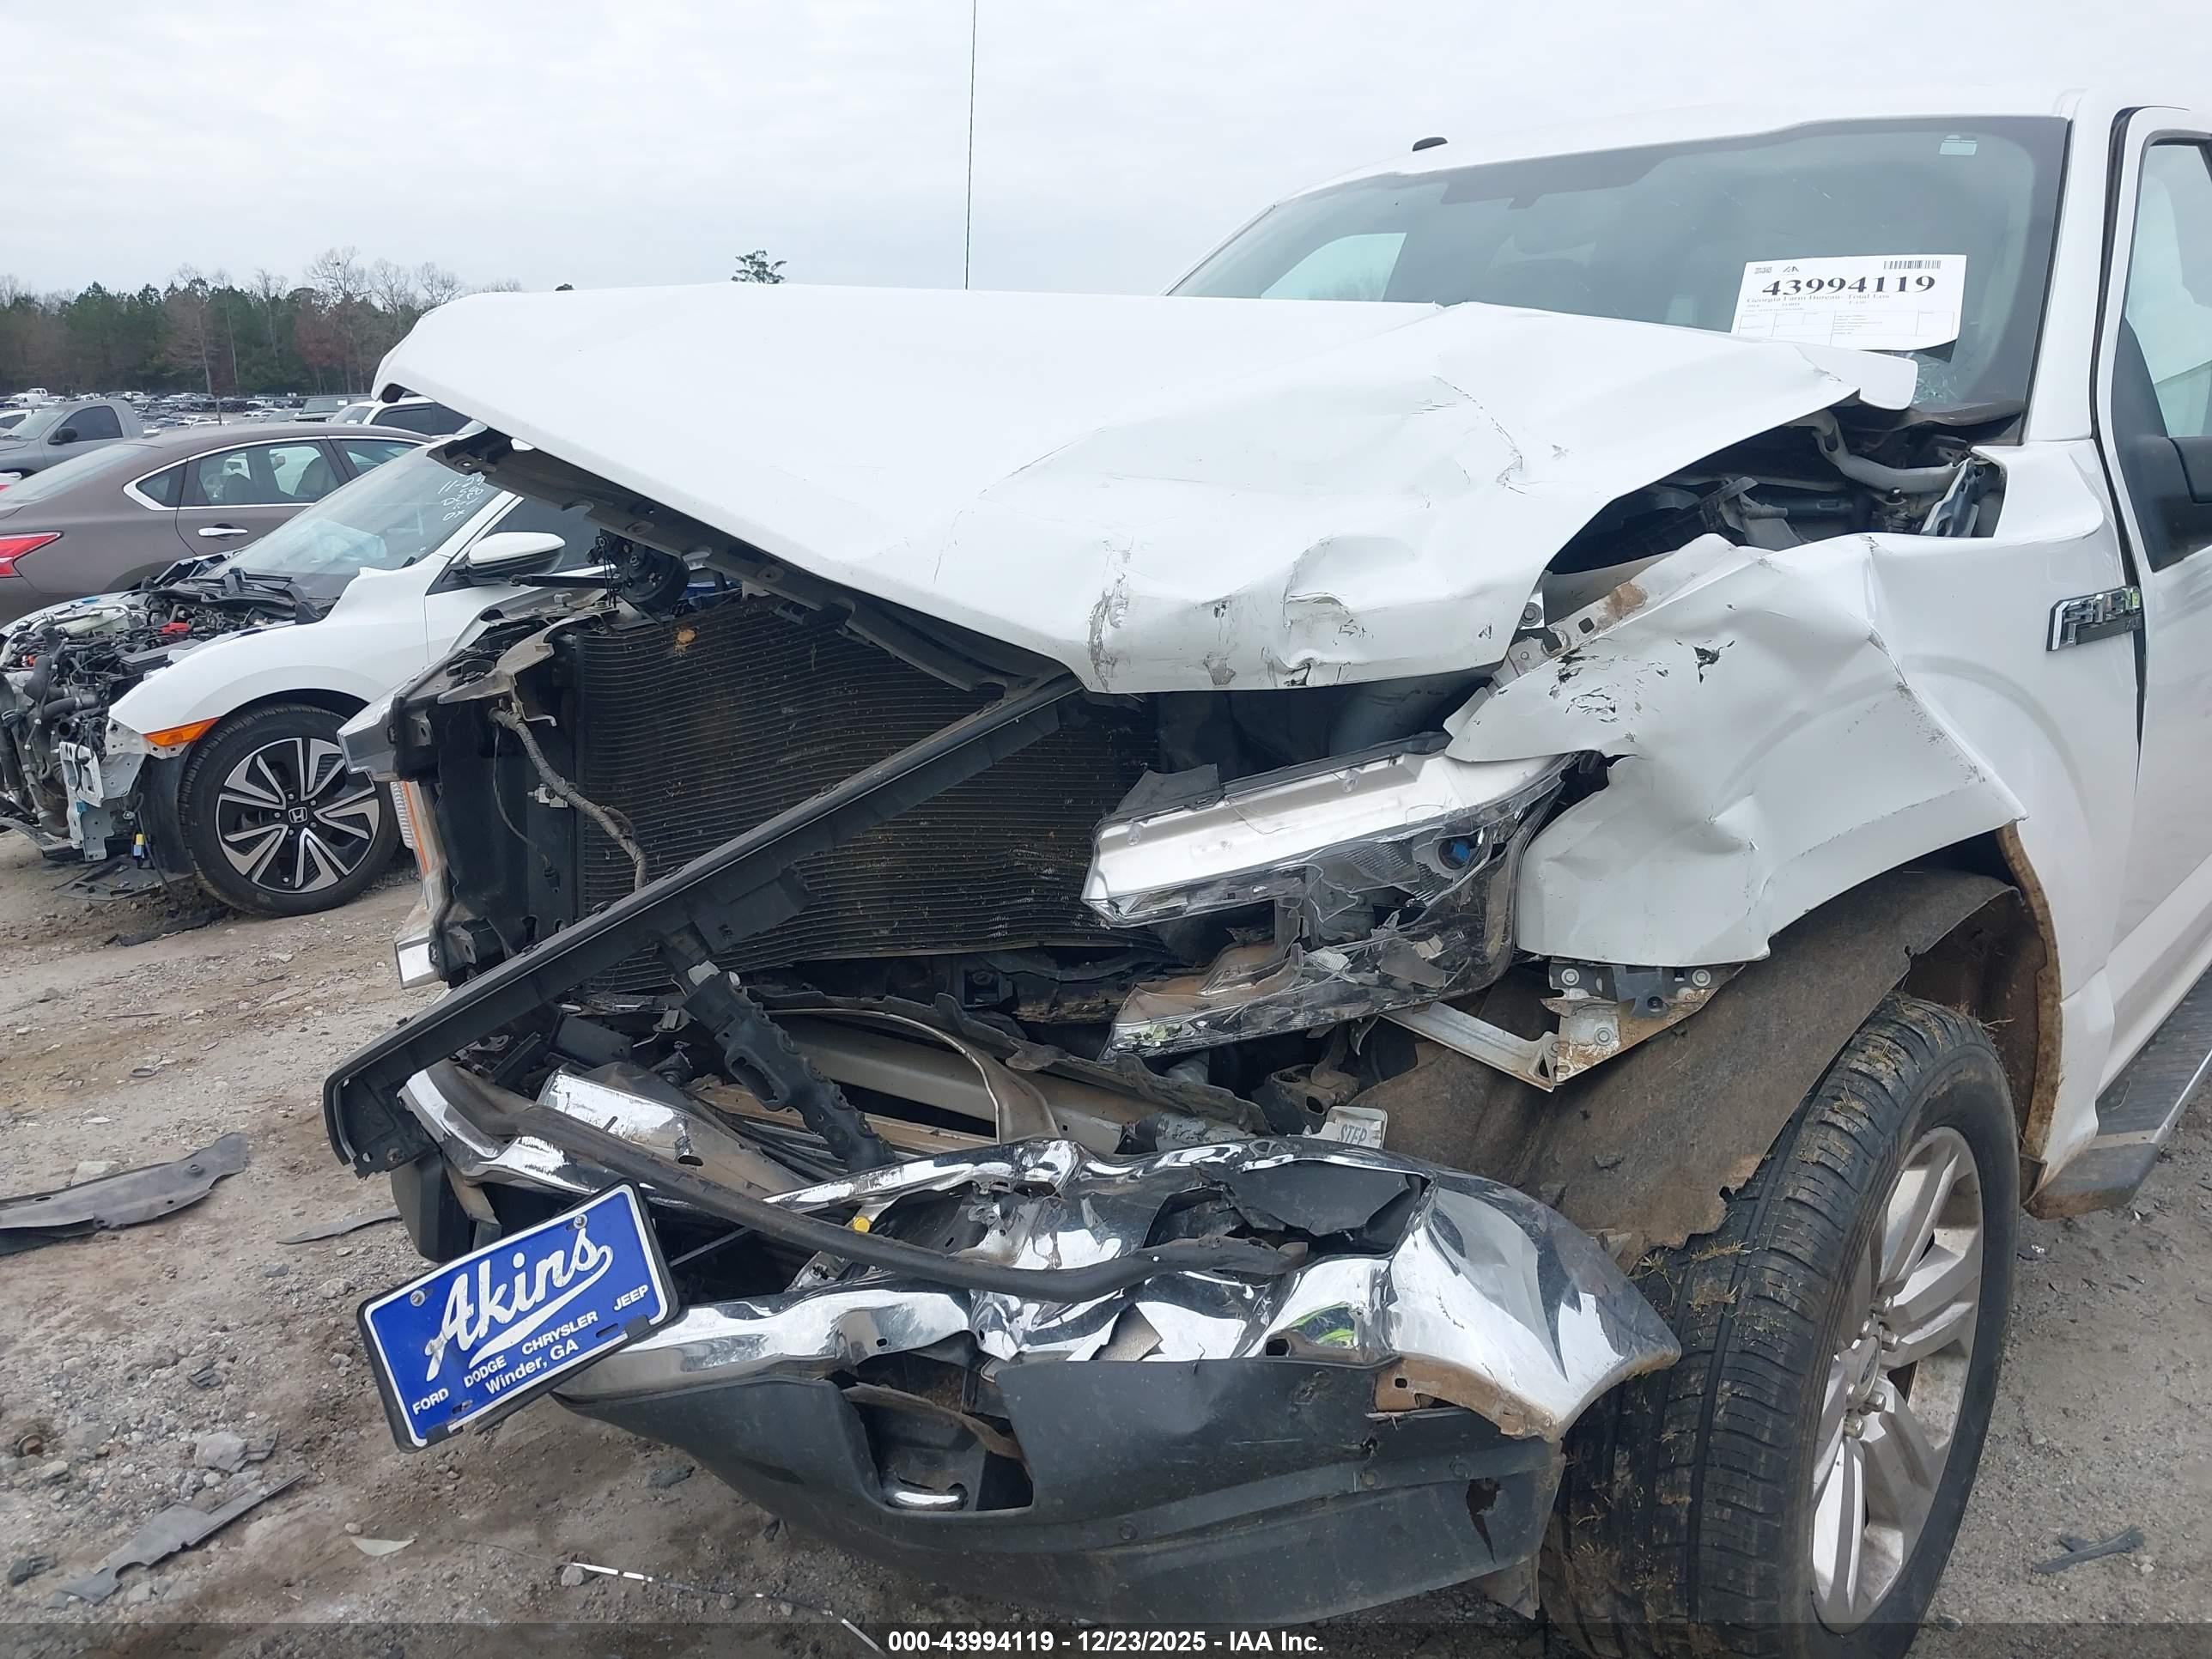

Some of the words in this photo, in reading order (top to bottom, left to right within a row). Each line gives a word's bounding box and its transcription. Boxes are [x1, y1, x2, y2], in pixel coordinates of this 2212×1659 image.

[1762, 275, 1936, 295] 43994119
[412, 1387, 450, 1416] FORD
[464, 1354, 507, 1389] DODGE
[521, 1310, 599, 1356] CHRYSLER
[613, 1284, 649, 1312] JEEP
[424, 1227, 614, 1382] Akins
[485, 1355, 548, 1395] Winder,
[550, 1340, 579, 1363] GA
